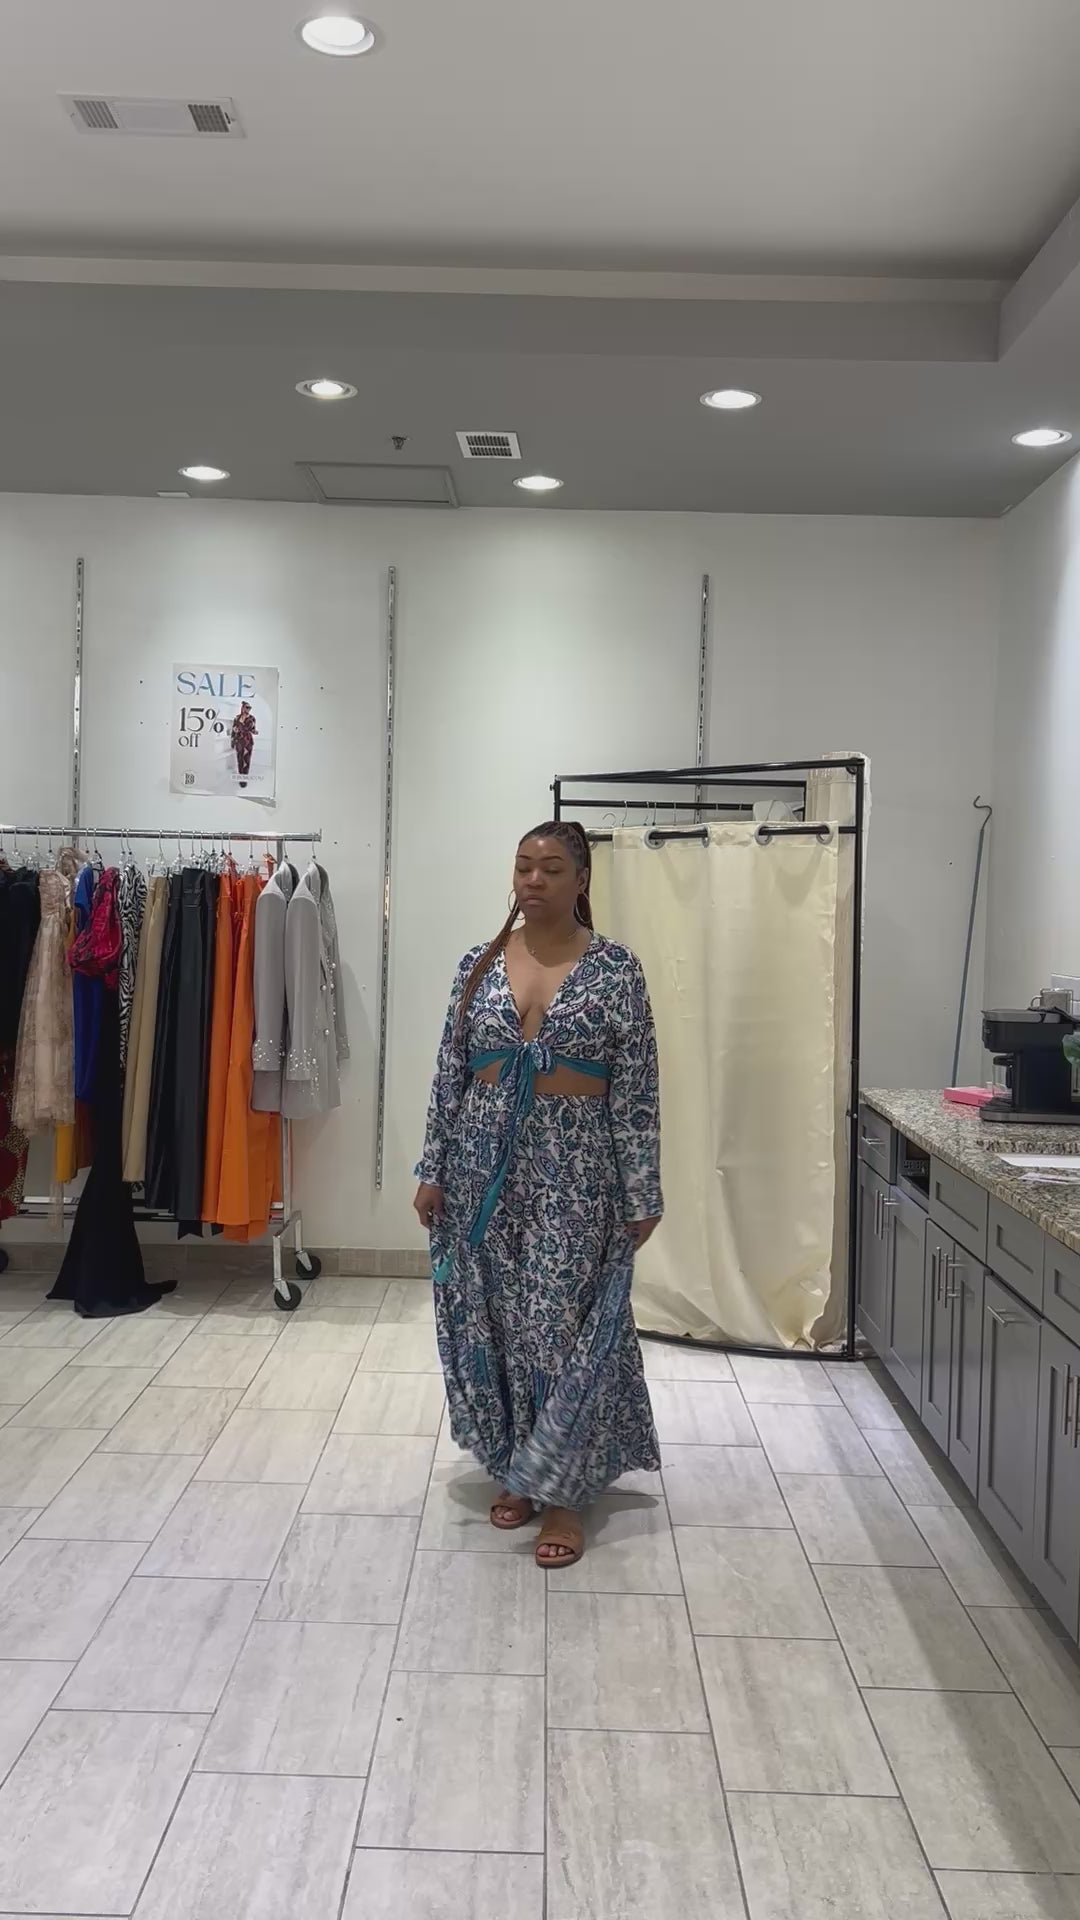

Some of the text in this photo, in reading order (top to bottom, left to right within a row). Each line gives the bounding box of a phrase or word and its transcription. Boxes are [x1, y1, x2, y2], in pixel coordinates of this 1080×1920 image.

[177, 671, 256, 698] SALE
[180, 707, 225, 734] 15%
[178, 732, 201, 748] off
